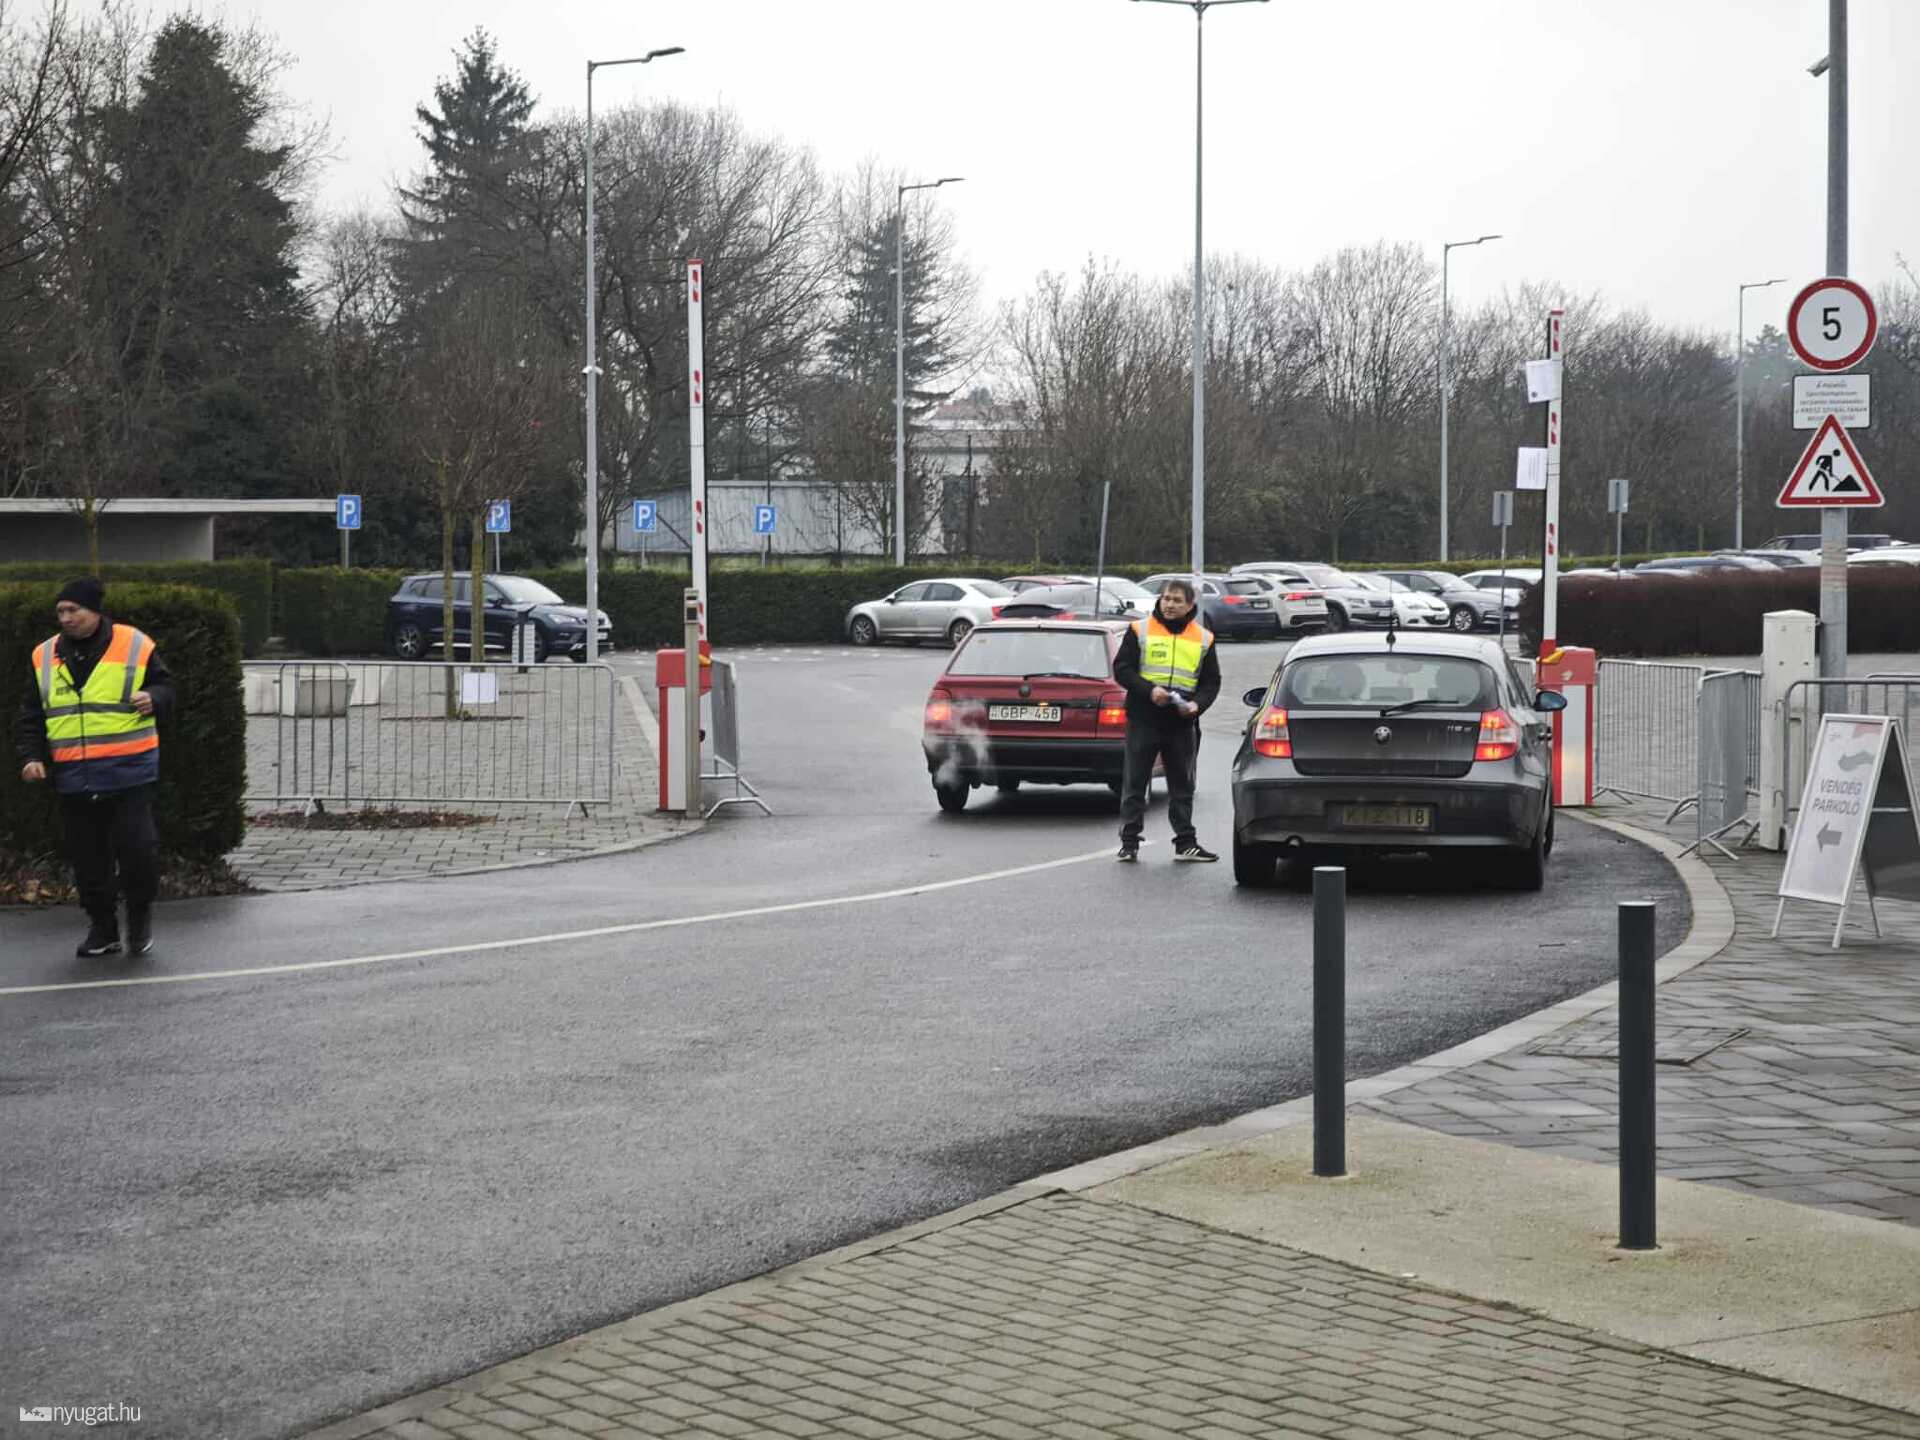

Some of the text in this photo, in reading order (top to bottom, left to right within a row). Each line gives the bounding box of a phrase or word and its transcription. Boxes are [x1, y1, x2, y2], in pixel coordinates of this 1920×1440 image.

[1823, 306, 1842, 341] 5
[342, 499, 356, 525] P
[490, 504, 504, 528] P
[638, 504, 652, 529] P
[758, 508, 772, 531] P
